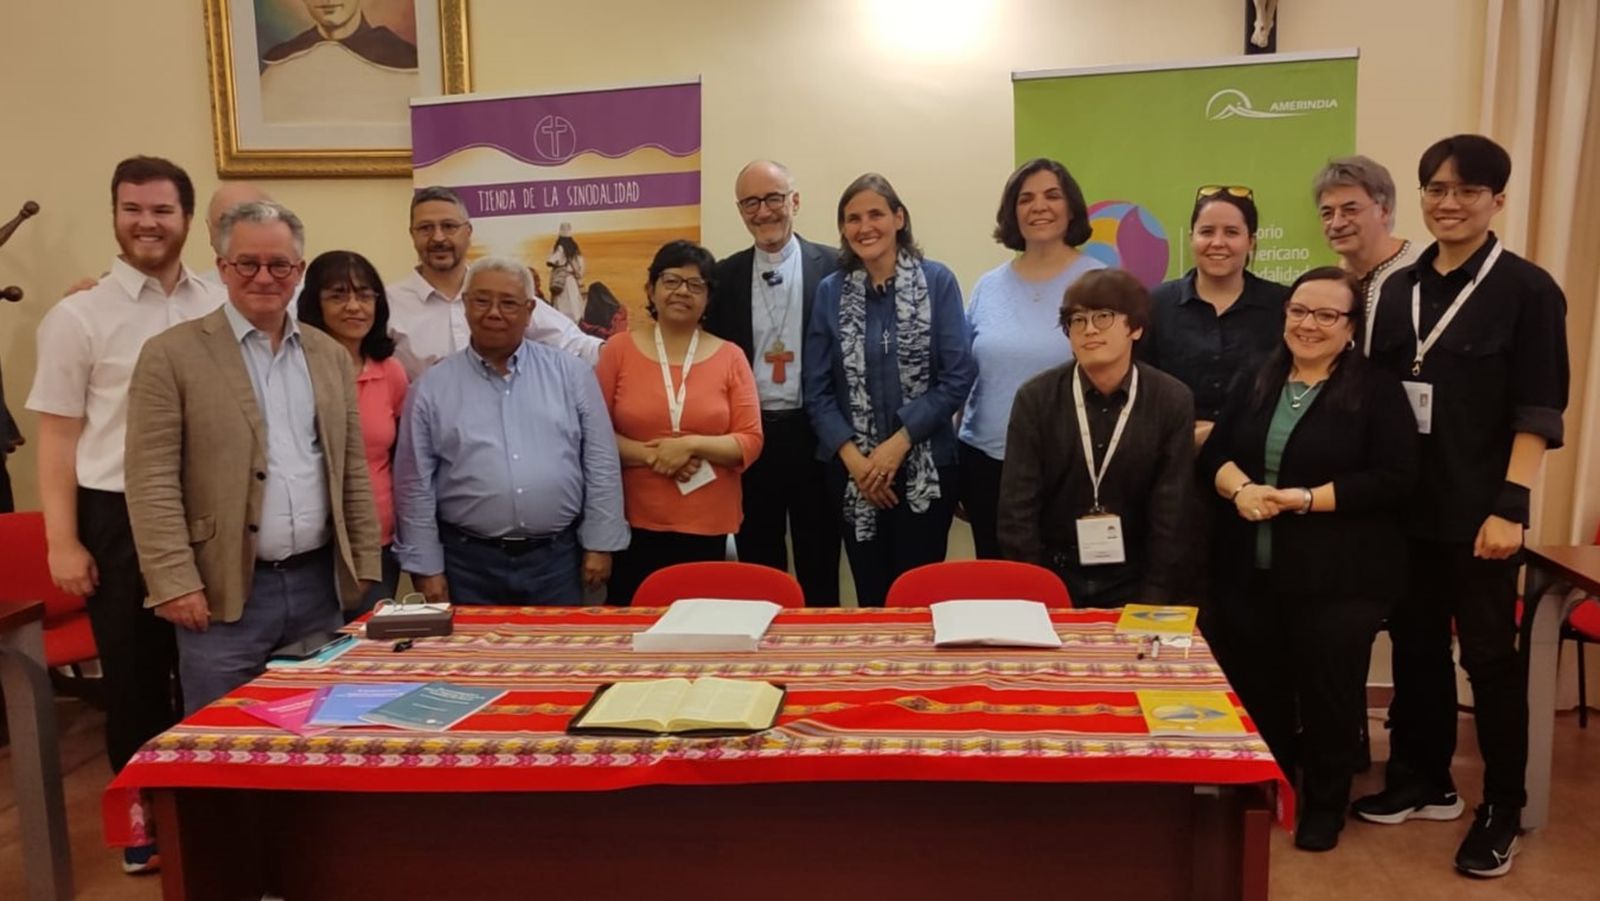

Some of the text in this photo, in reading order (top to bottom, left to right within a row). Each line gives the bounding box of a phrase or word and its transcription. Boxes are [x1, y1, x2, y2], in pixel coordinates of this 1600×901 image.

[1269, 99, 1338, 113] AMERINDIA
[477, 181, 640, 212] TIENDA DE LA SINODALIDAD
[1253, 224, 1284, 240] orio
